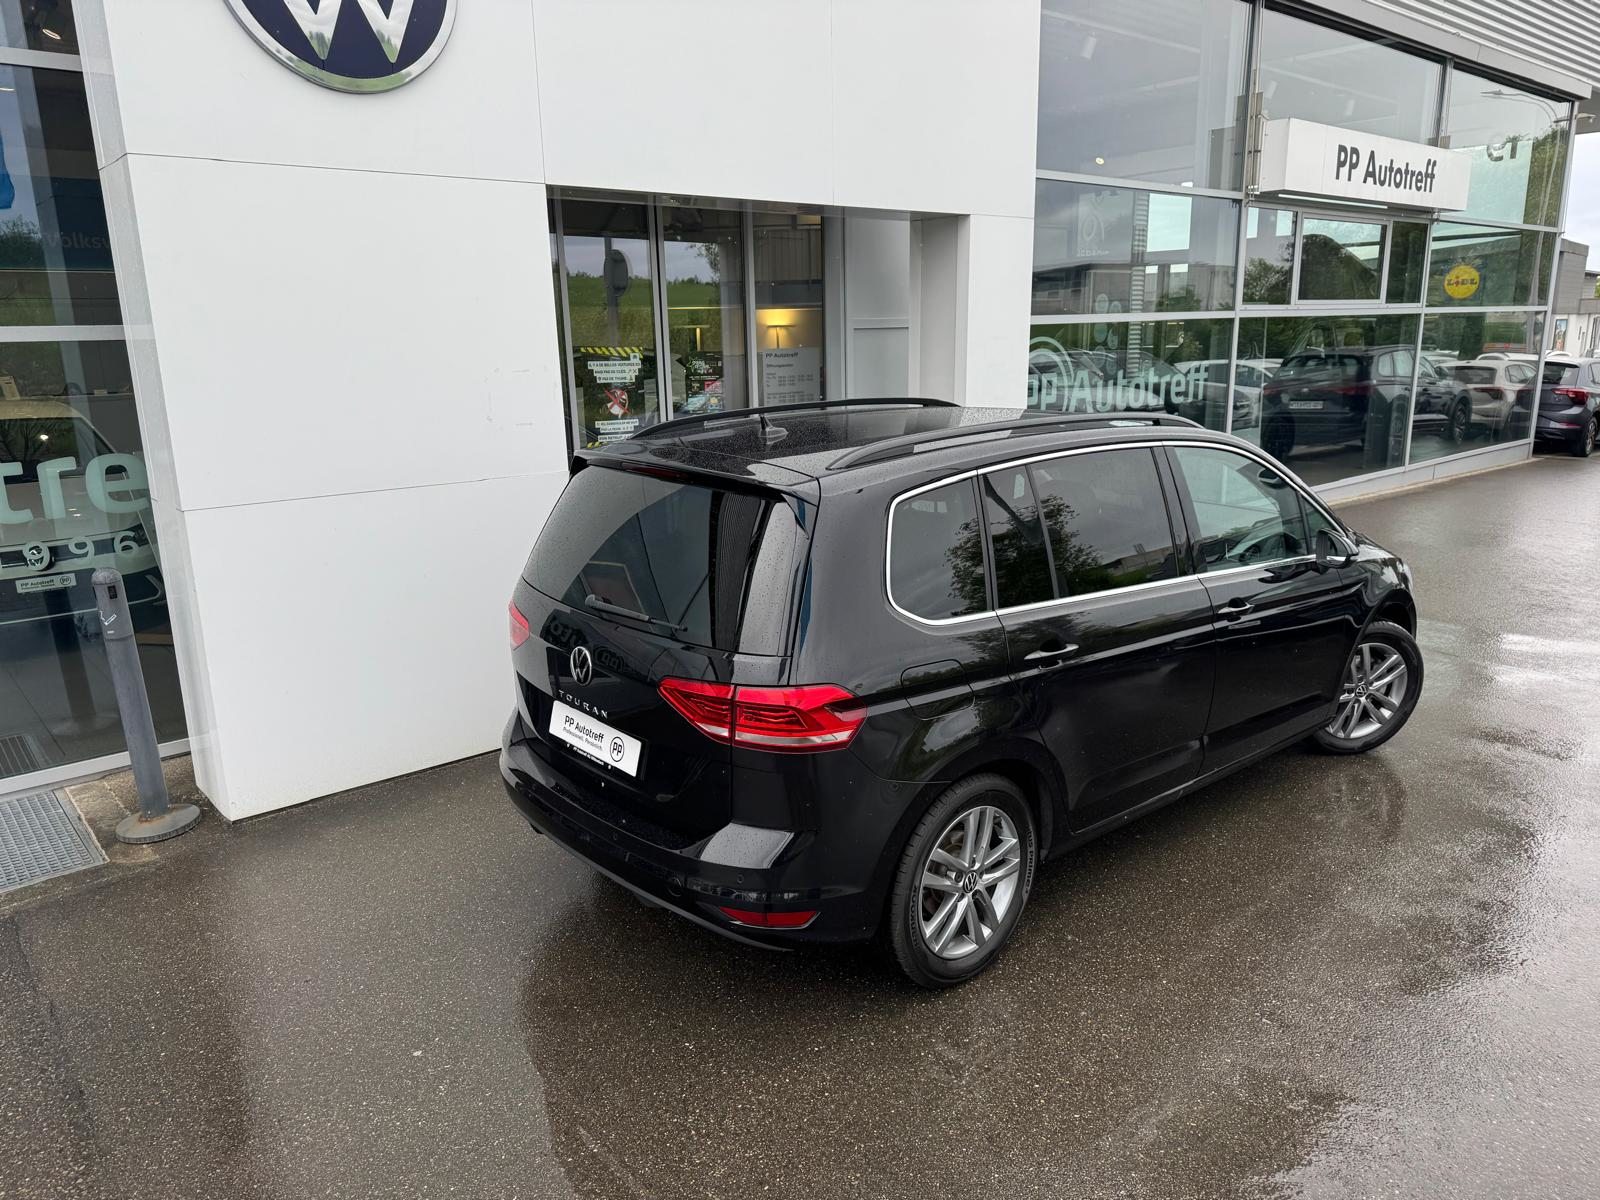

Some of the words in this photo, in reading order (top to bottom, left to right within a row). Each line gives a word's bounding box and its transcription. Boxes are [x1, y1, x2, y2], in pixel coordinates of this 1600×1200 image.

[1335, 144, 1360, 182] PP
[1362, 150, 1437, 193] Autotreff
[1068, 363, 1209, 414] Autotreff
[558, 689, 608, 719] TOURAN
[564, 715, 575, 728] PP
[574, 722, 605, 743] Autotreff
